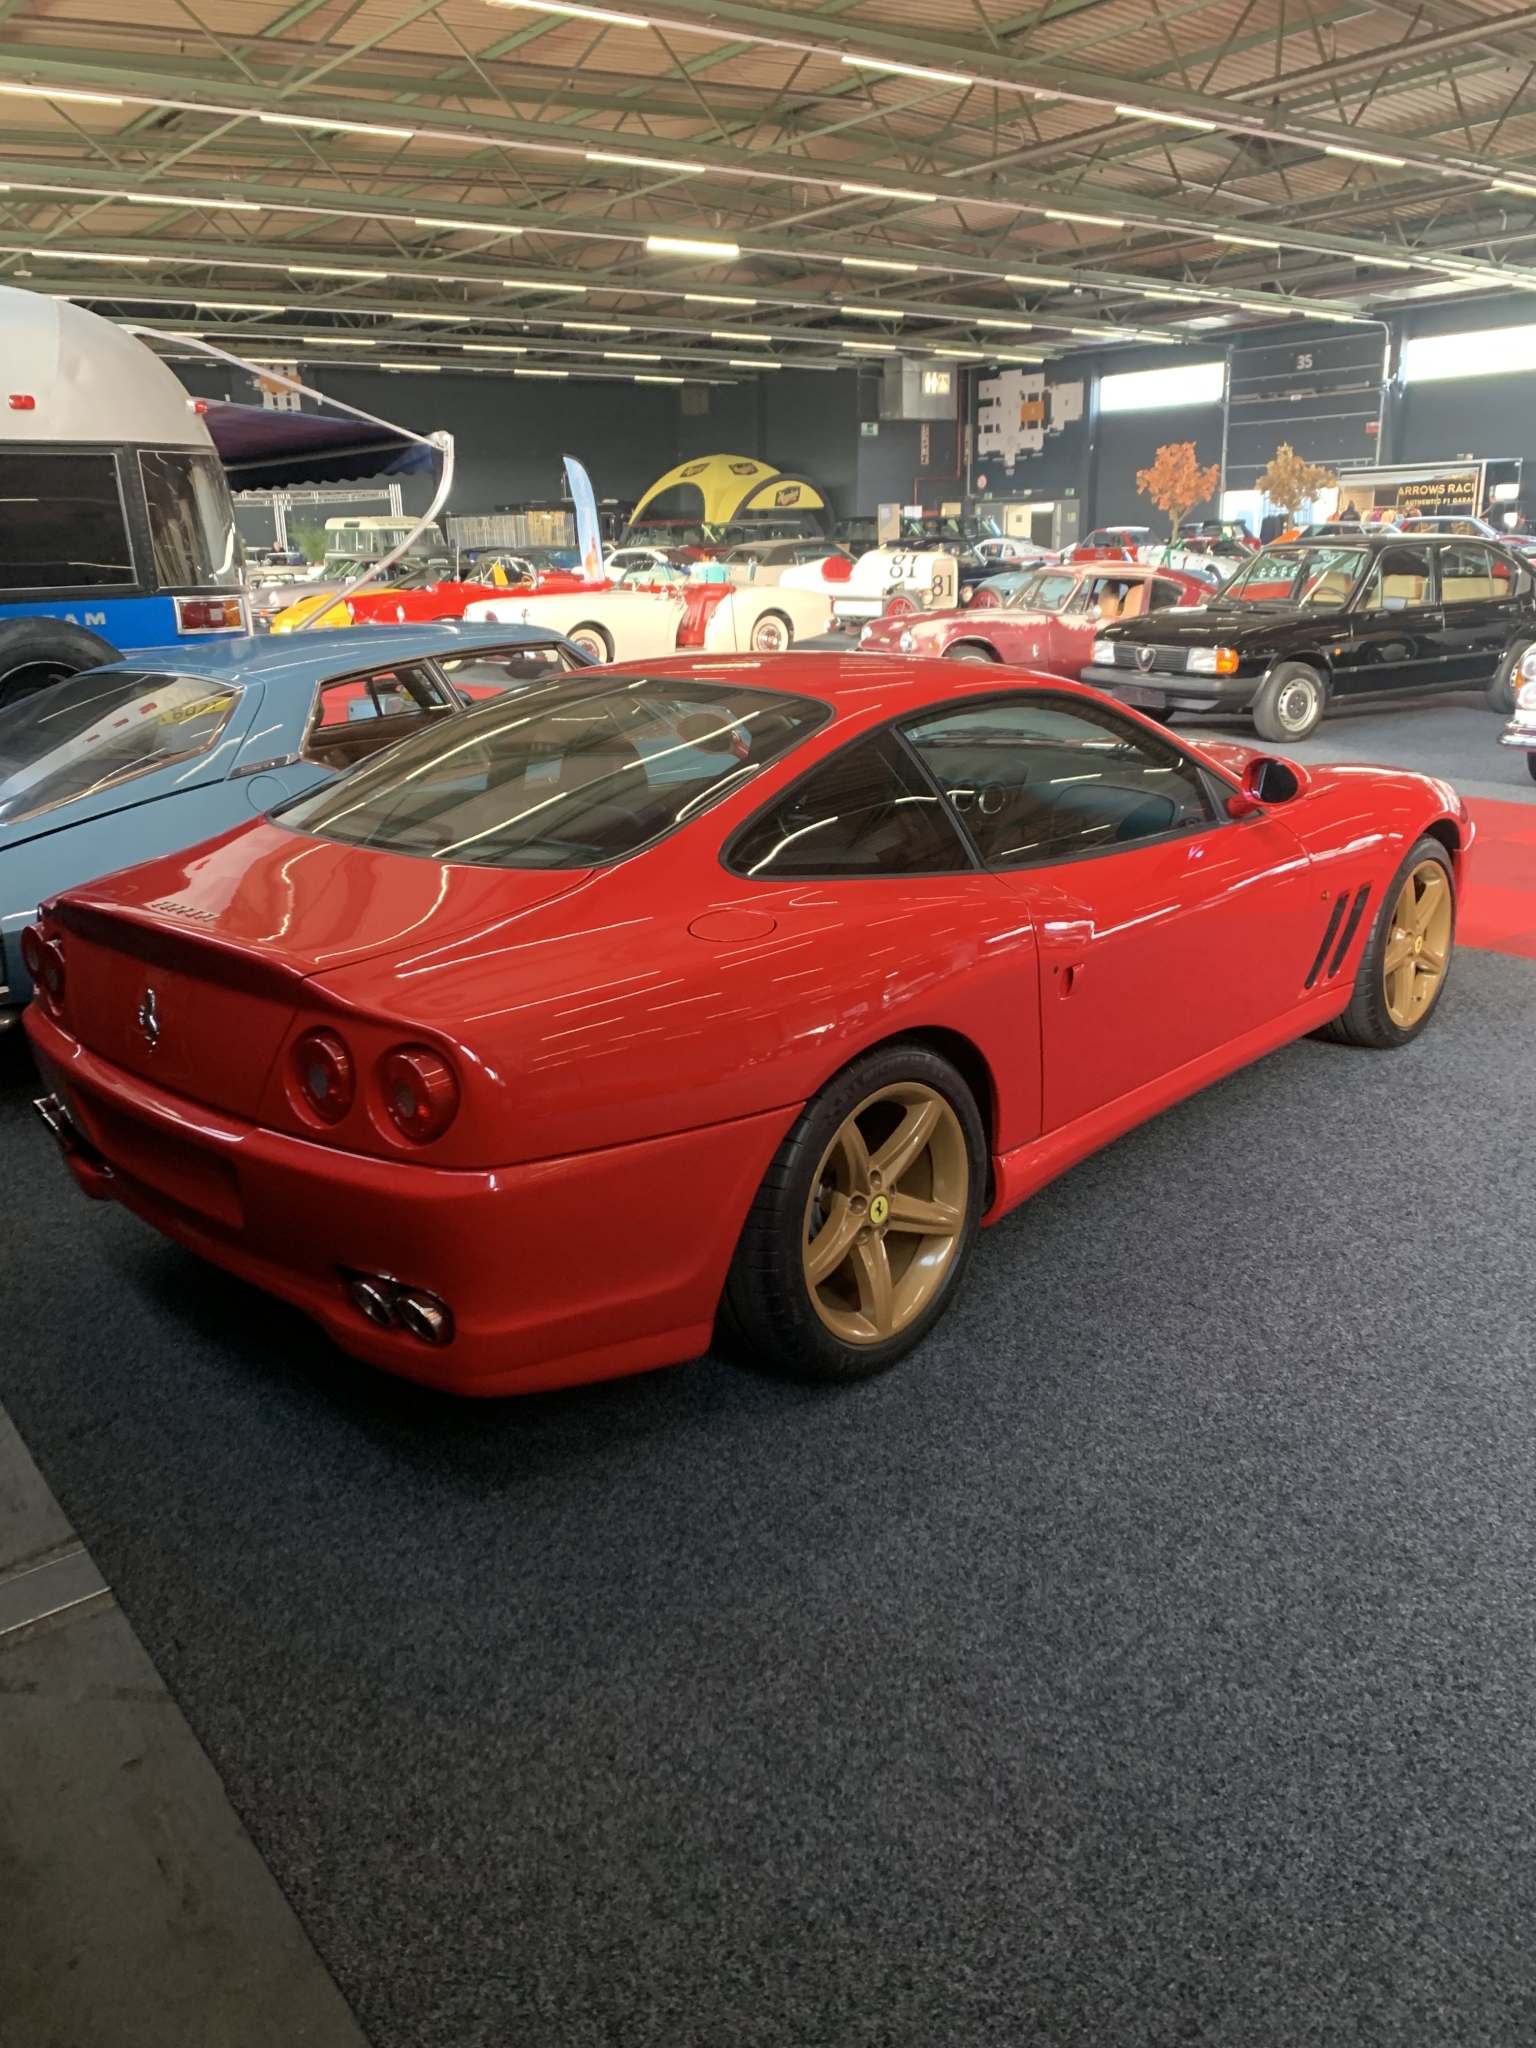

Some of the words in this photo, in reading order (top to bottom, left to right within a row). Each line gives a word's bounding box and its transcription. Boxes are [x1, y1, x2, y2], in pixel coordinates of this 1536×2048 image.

[1297, 354, 1312, 369] 35
[1398, 484, 1445, 495] ARROWS
[1405, 498, 1441, 506] AUTHENTIC
[889, 554, 919, 579] 81
[932, 575, 953, 597] 81
